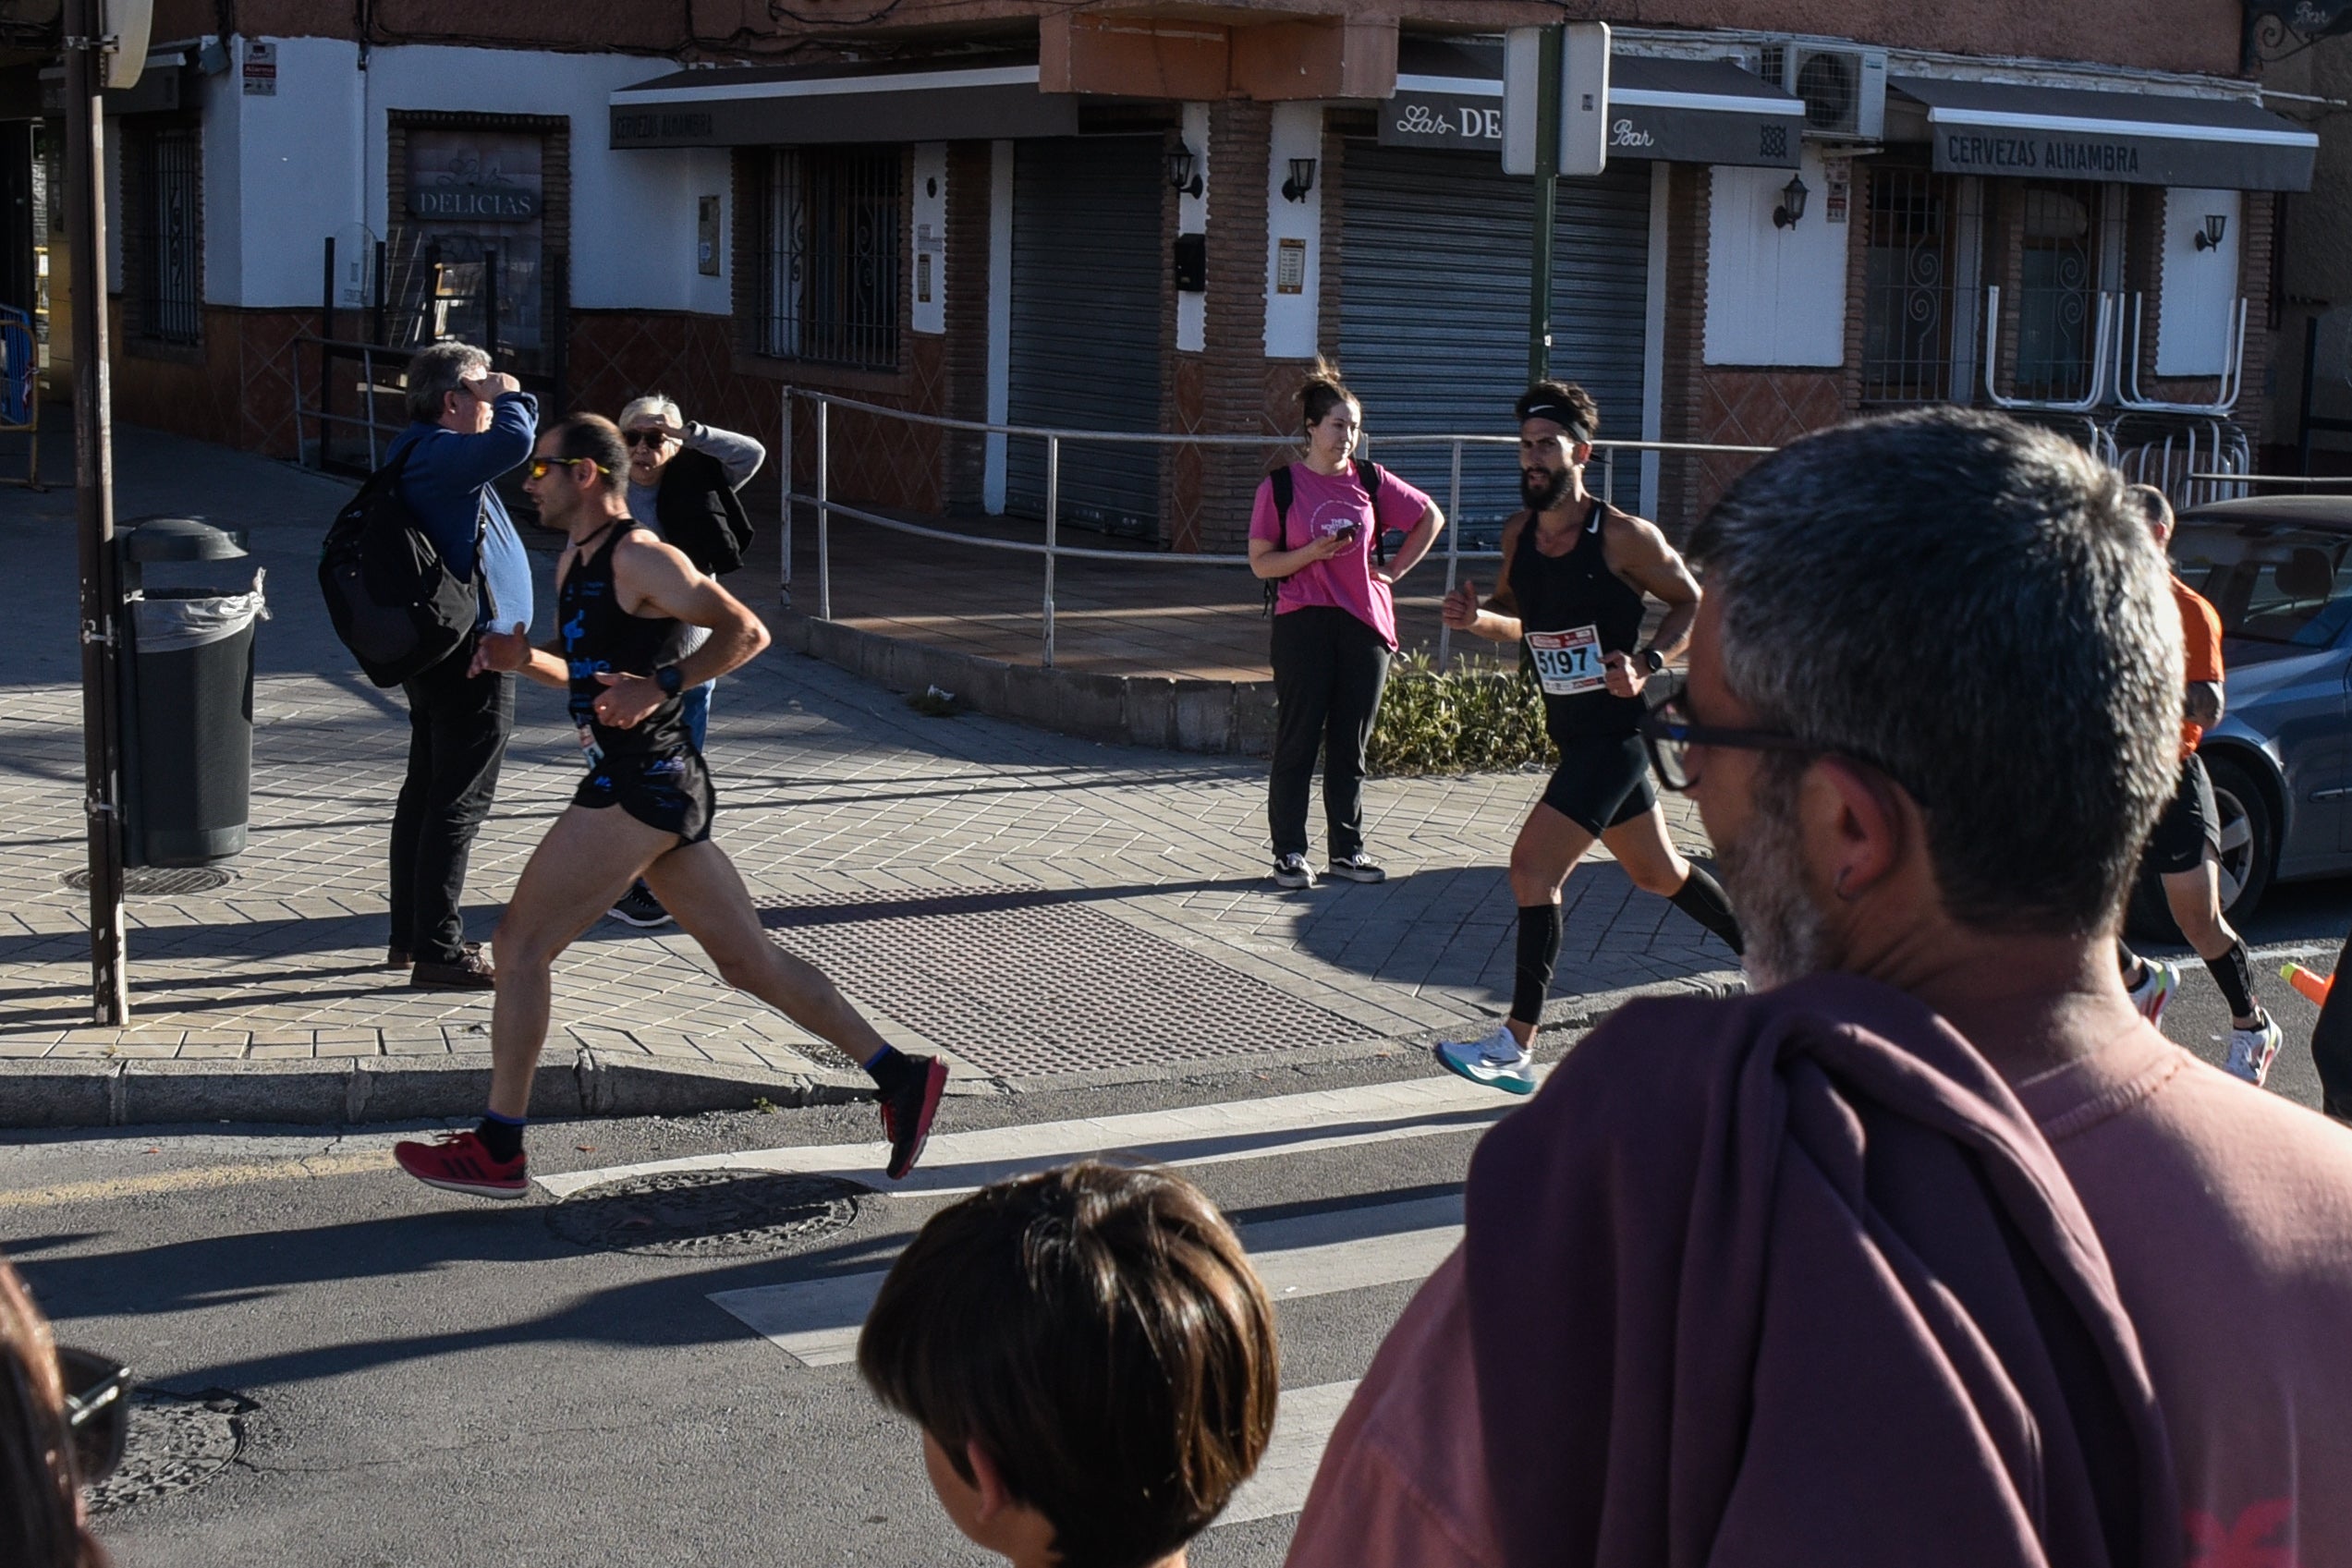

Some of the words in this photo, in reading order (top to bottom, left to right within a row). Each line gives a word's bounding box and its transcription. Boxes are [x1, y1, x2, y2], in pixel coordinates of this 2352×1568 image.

[2292, 1, 2331, 24] Bar
[1396, 104, 1456, 135] Las
[1458, 107, 1502, 139] DE
[1609, 119, 1654, 147] Bar
[1948, 135, 2037, 167] CERVEZAS
[2044, 140, 2139, 174] ALHAMBRA
[420, 192, 530, 214] DELICIAS
[1536, 648, 1588, 675] 5197
